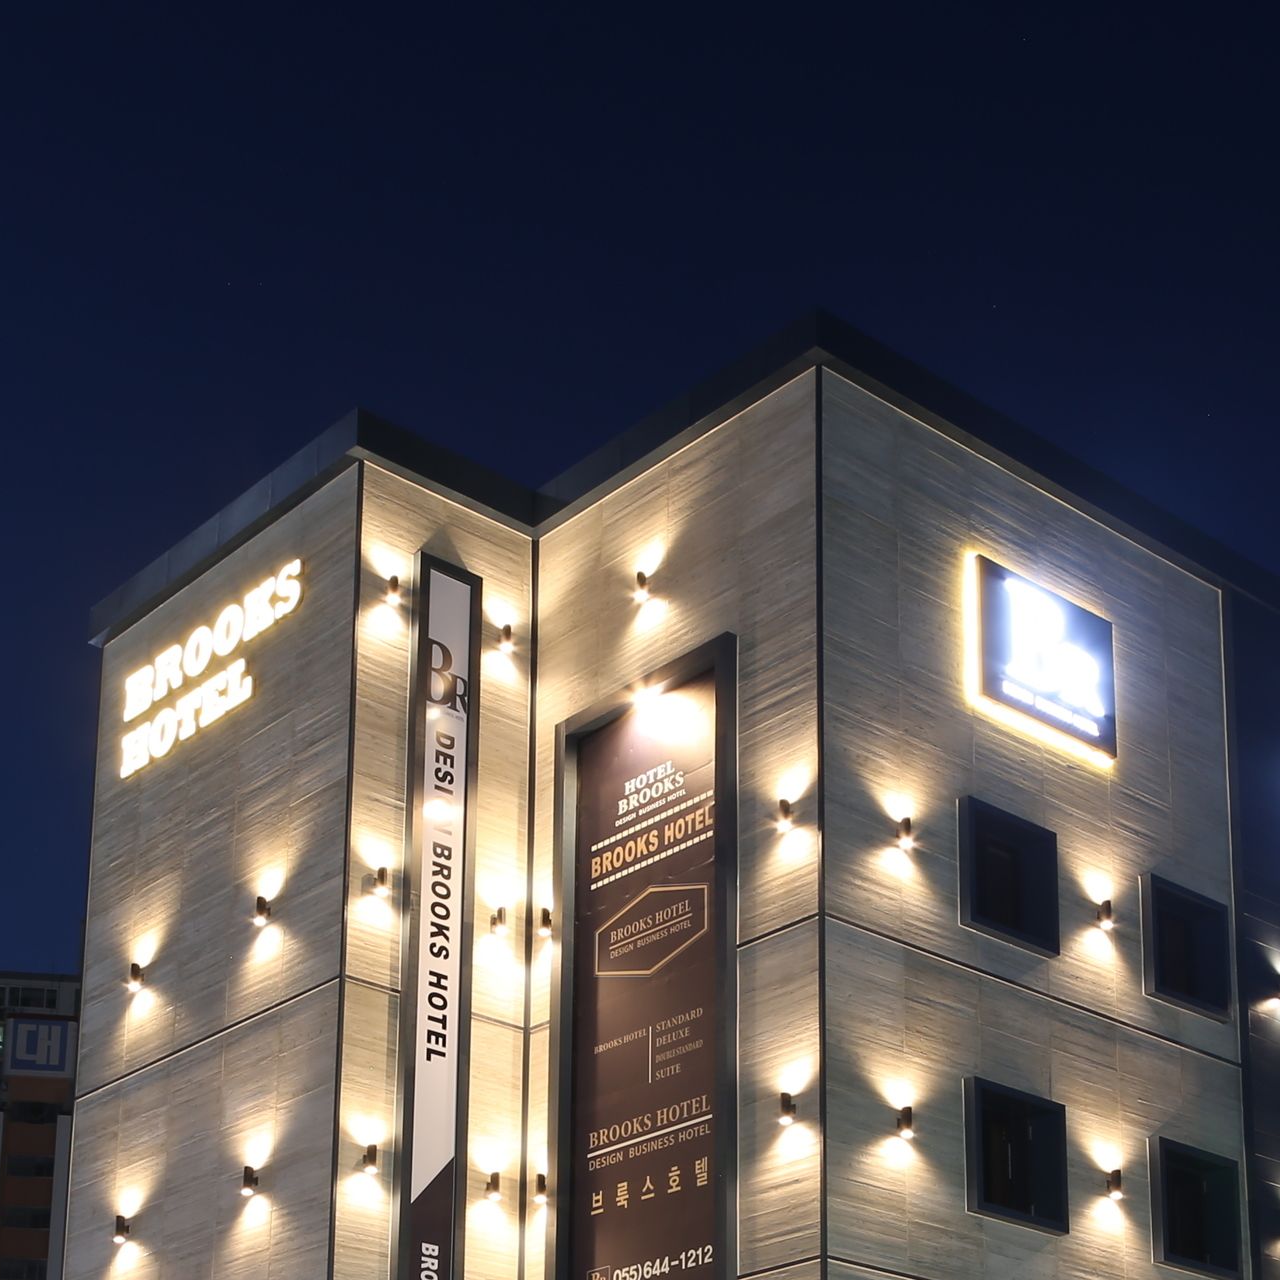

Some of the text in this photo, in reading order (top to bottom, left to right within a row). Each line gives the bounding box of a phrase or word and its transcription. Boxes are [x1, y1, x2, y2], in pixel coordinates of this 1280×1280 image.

[123, 558, 302, 722] BROOKS
[120, 657, 252, 779] HOTEL
[617, 770, 686, 816] BROOKS
[624, 760, 676, 796] HOTEL
[614, 788, 687, 828] DESIGN BUSINESS HOTEL
[591, 804, 714, 880] BROOKS HOTEL
[428, 841, 453, 961] BROOKS
[610, 899, 692, 944] BROOKS HOTEL
[609, 919, 692, 959] DESIGN BUSINESS HOTEL
[426, 970, 448, 1062] HOTEL
[655, 1007, 703, 1033] STANDARD
[655, 1026, 691, 1048] DELUXE
[593, 1028, 647, 1055] BROOKS HOTEL
[655, 1063, 682, 1081] SUITE
[589, 1094, 711, 1150] BROOKS HOTEL
[588, 1123, 711, 1172] DESIGN BUSINESS HOTEL
